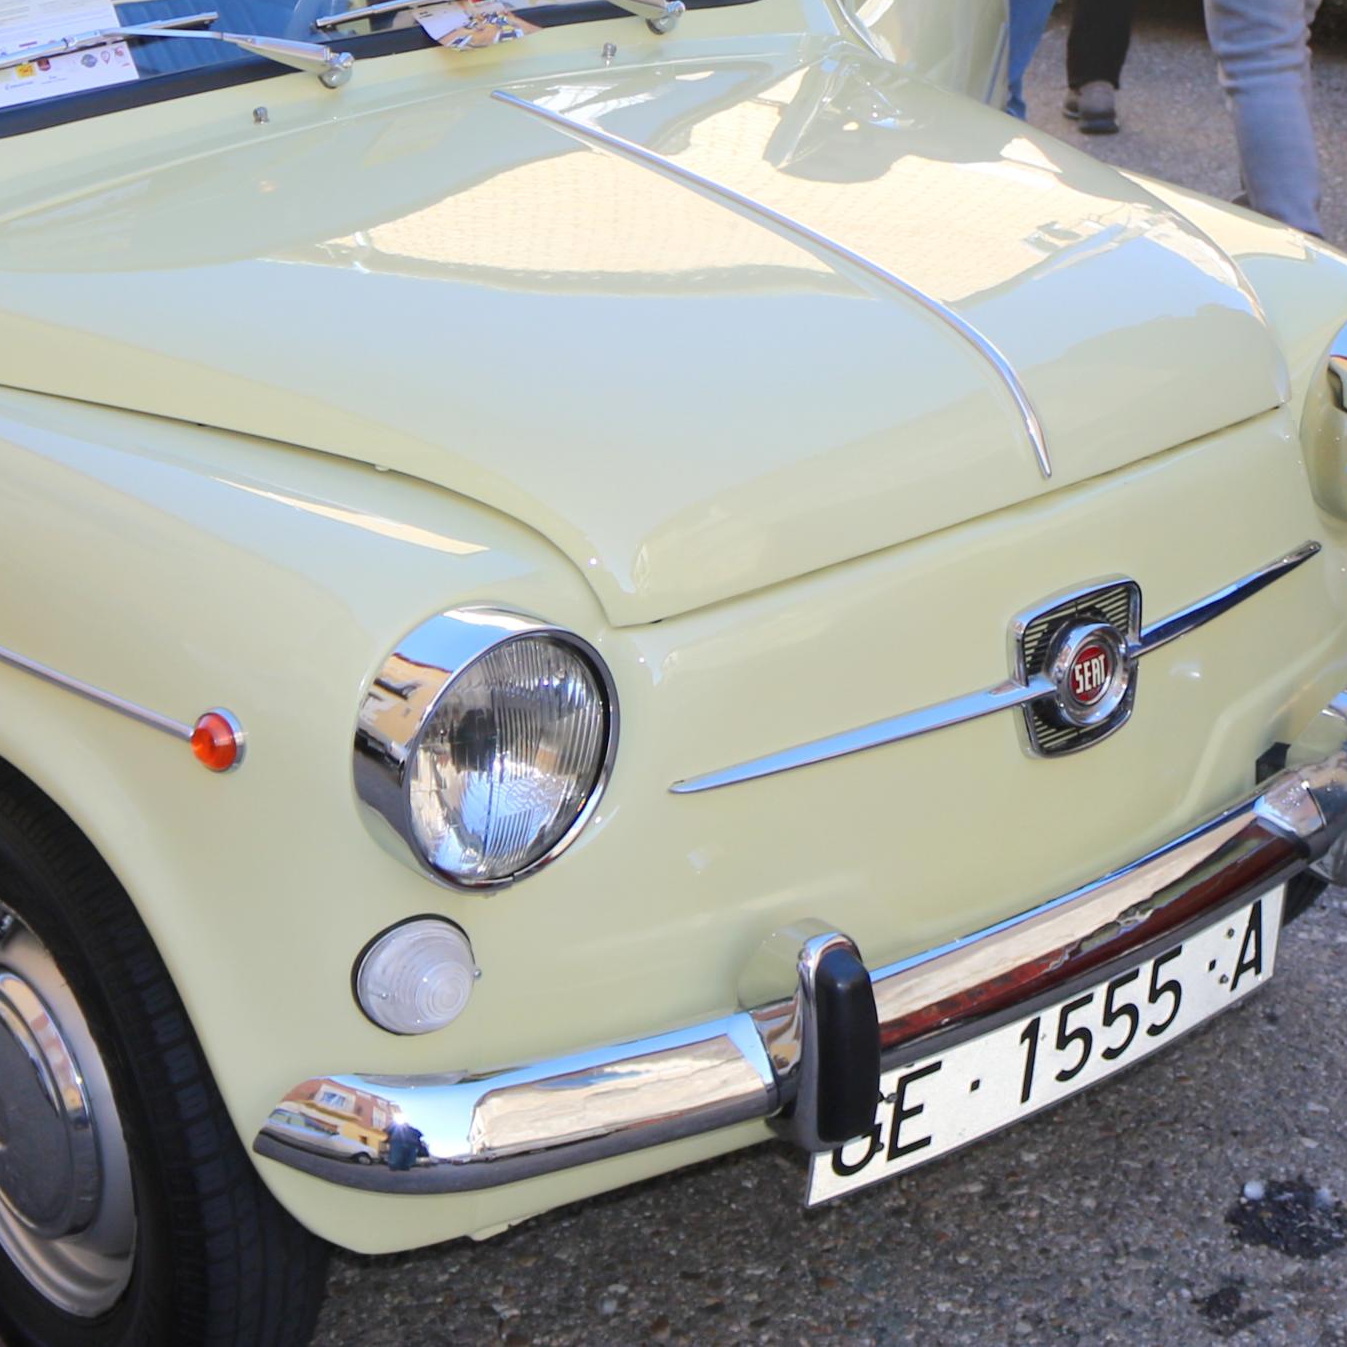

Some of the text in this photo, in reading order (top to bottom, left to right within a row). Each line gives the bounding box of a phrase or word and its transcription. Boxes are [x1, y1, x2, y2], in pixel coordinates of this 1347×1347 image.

[1075, 654, 1105, 694] SEAT
[1020, 944, 1183, 1105] 1555
[1229, 899, 1263, 992] A
